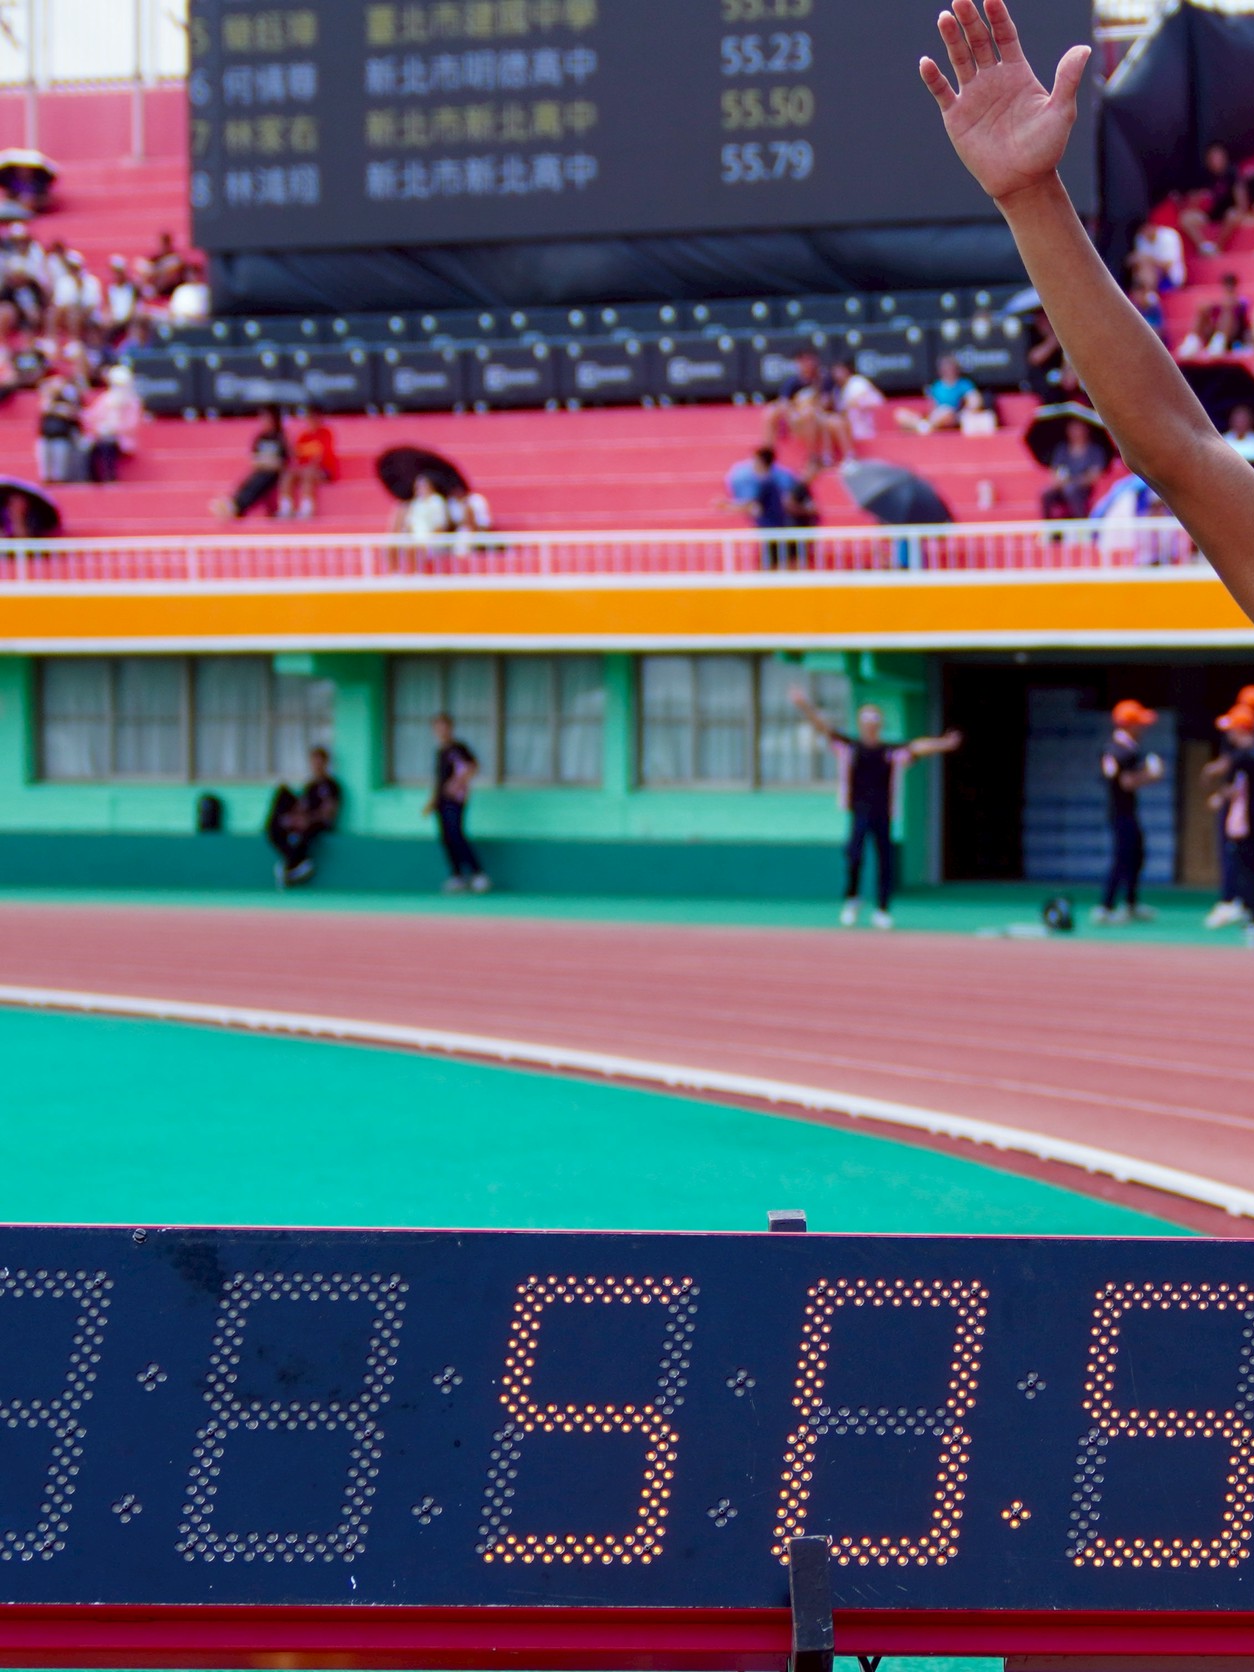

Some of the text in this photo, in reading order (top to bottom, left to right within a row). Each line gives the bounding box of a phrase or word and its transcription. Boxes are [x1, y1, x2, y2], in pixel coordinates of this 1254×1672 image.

[190, 67, 212, 107] 6
[721, 31, 813, 76] 55.23
[191, 119, 211, 156] 7
[721, 86, 815, 130] 55.50
[191, 170, 212, 208] 8
[721, 140, 815, 184] 55.79
